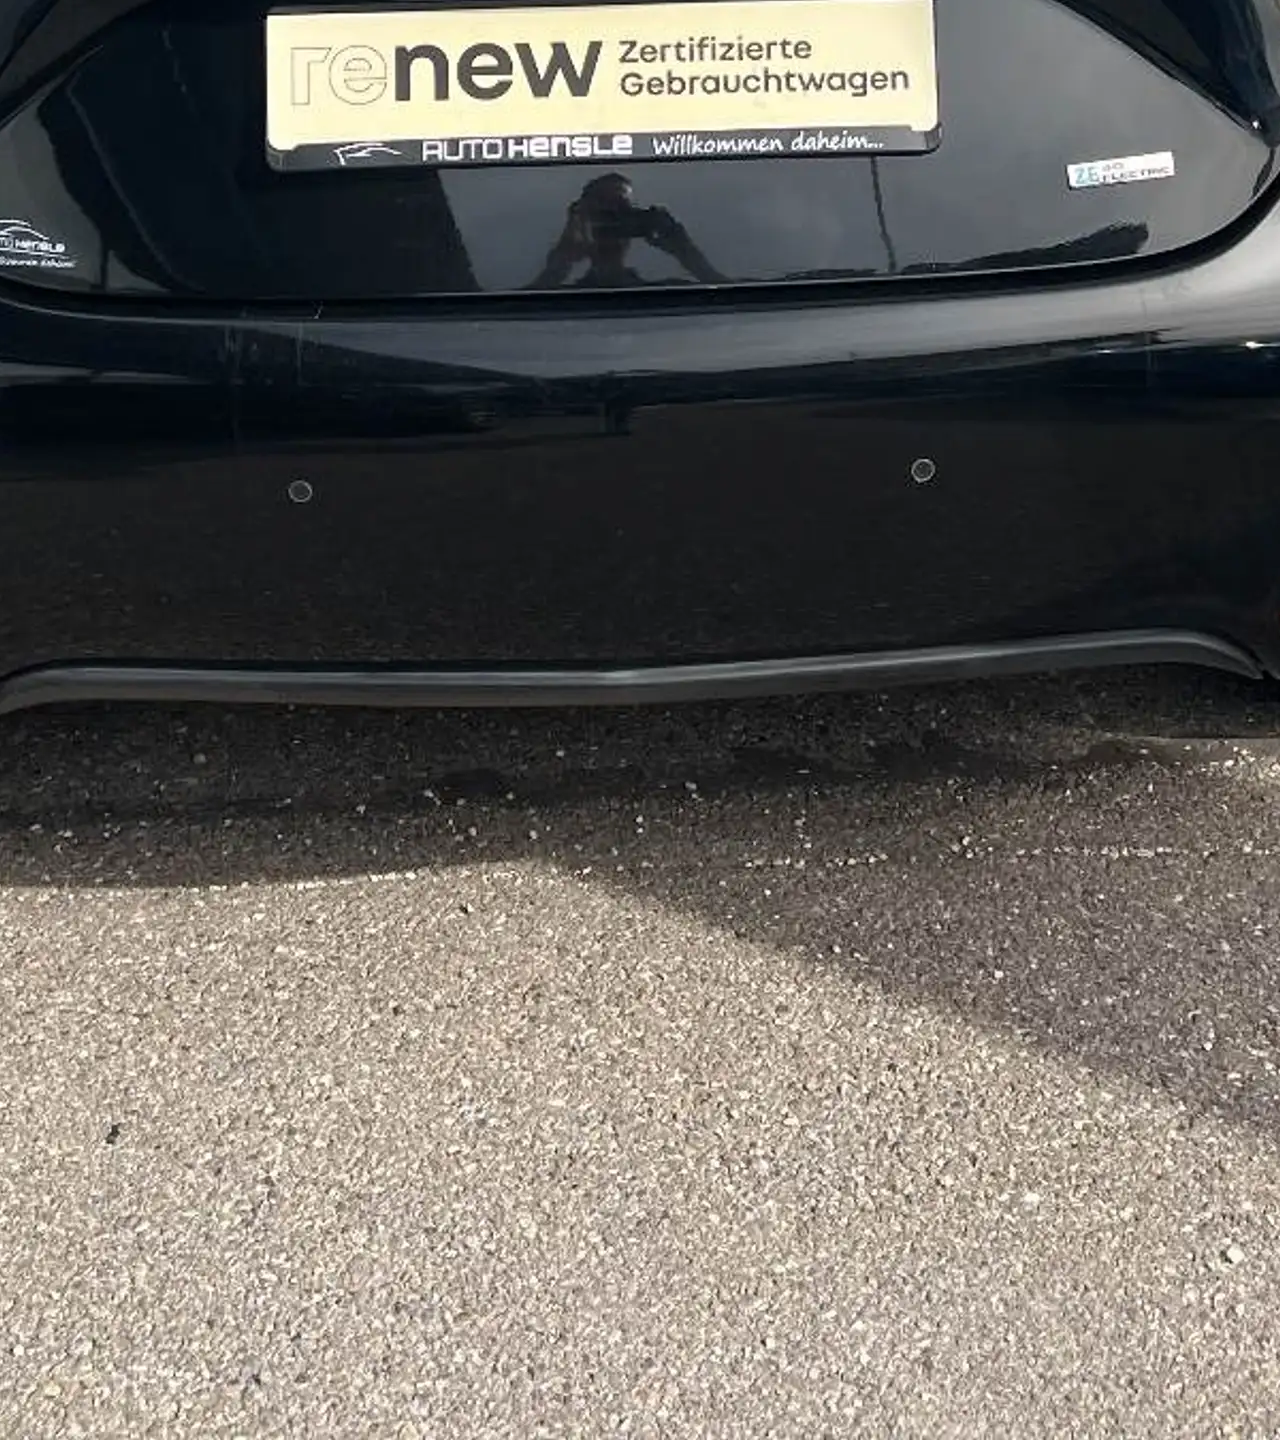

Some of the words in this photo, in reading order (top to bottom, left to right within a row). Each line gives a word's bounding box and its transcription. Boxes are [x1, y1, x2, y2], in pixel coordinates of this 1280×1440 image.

[619, 35, 813, 64] Zertifizierte
[290, 40, 603, 106] renew
[620, 67, 910, 98] Gebrauchtwagen
[651, 133, 784, 156] Willkommen
